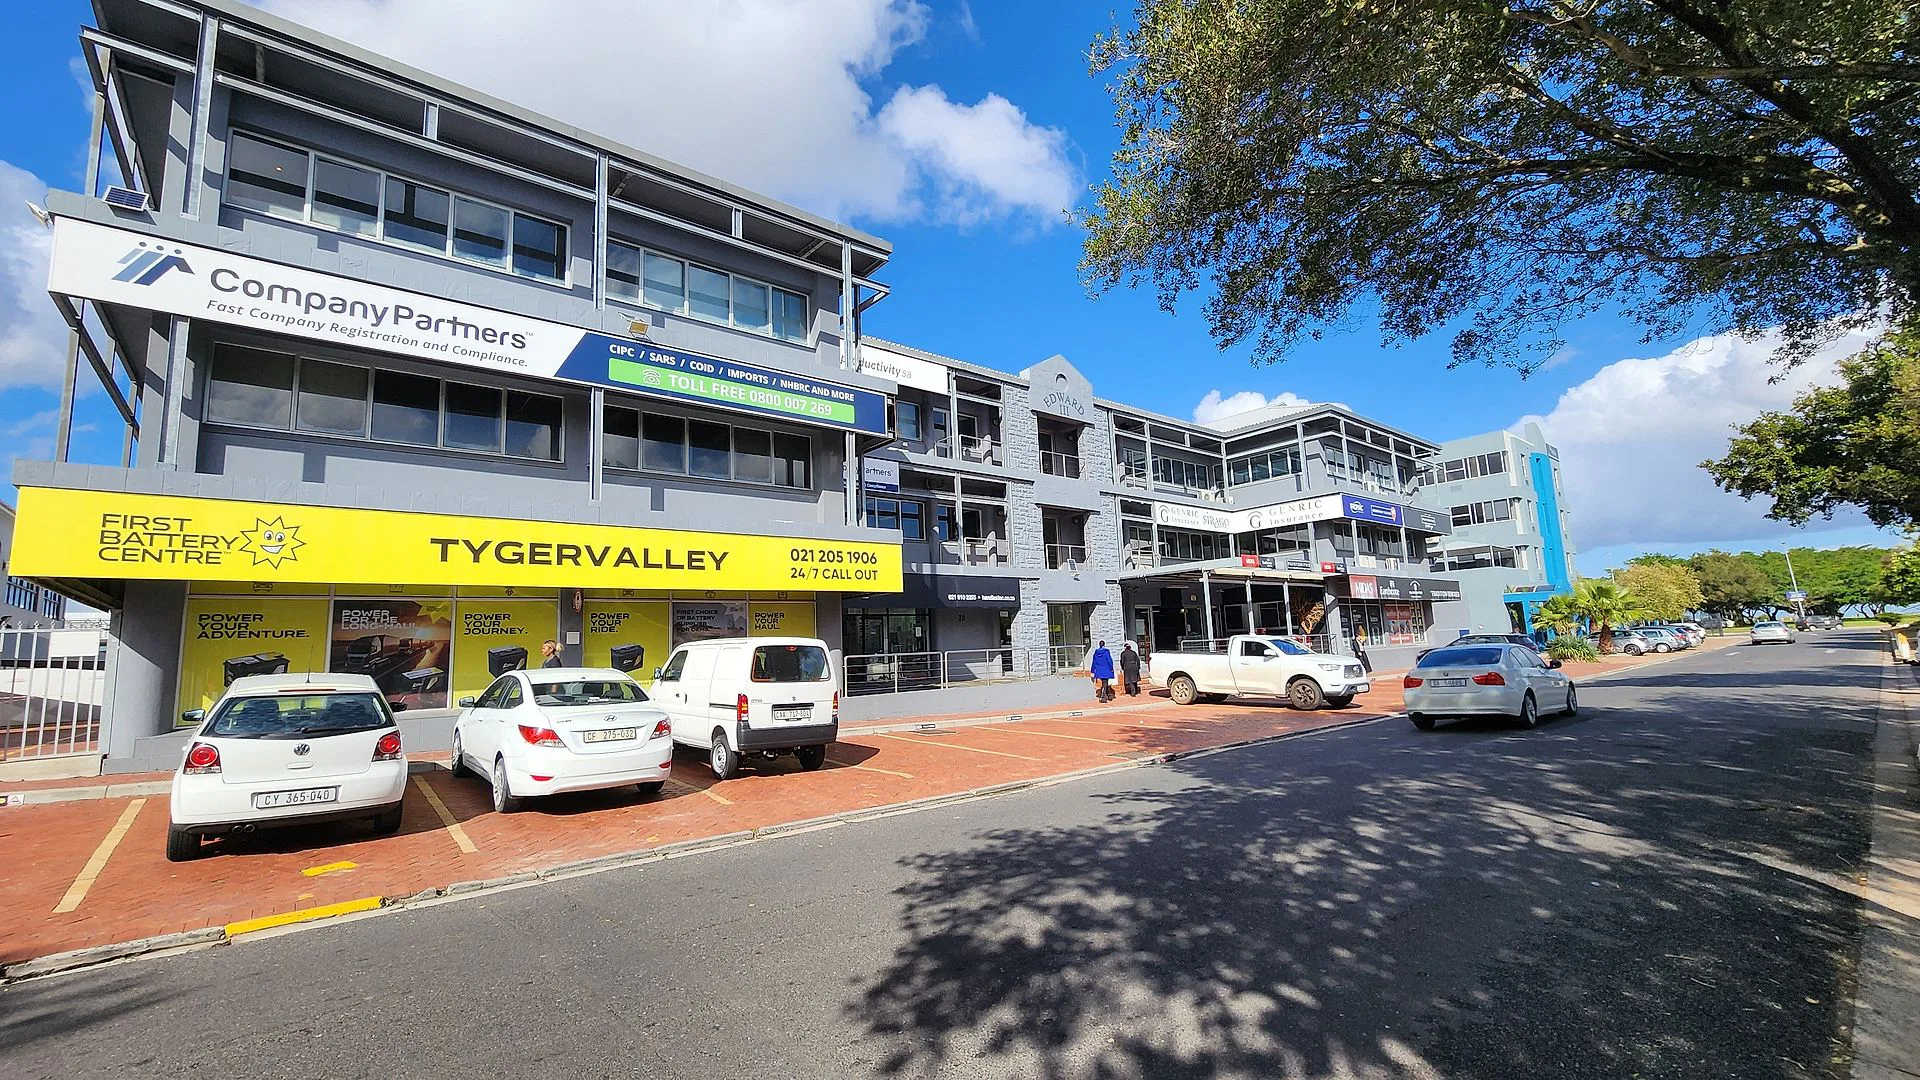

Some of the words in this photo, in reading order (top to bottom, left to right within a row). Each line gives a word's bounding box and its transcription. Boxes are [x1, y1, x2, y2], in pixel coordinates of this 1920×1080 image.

[206, 299, 244, 316] Fast
[249, 308, 326, 332] Company
[329, 322, 419, 347] Registration
[423, 341, 449, 352] and
[452, 345, 528, 367] Compliance.
[609, 344, 635, 358] CIPC
[649, 352, 676, 366] SARS
[689, 360, 715, 374] COID
[727, 368, 769, 385] IMPORTS
[780, 379, 811, 393] NHBRC
[811, 385, 830, 397] AND
[831, 390, 855, 402] MORE
[668, 373, 708, 393] TOLL
[711, 382, 746, 401] FREE
[749, 389, 781, 407] 0800
[784, 396, 807, 411] 007
[810, 401, 832, 416] 269
[1043, 391, 1085, 416] EDWARD
[1059, 404, 1070, 416] III
[1268, 499, 1323, 516] GENRIC
[102, 513, 192, 532] FIRST
[100, 530, 239, 550] BATTERY
[430, 538, 729, 571] TYGERVALLEY
[790, 548, 815, 562] 021
[818, 550, 844, 563] 205
[847, 551, 877, 565] 1906
[790, 566, 819, 580] 24/7
[822, 568, 852, 580] CALL
[854, 569, 878, 580] OUT
[198, 613, 264, 622] POWER
[341, 609, 391, 618] POWER
[464, 613, 512, 621] POWER
[590, 612, 630, 620] POWER
[341, 616, 370, 624] FOR
[374, 616, 399, 624] THE
[463, 620, 501, 628] YOUR
[590, 619, 622, 627] YOUR
[197, 622, 250, 631] YOUR
[463, 627, 529, 636] JOURNEY.
[590, 626, 619, 634] RIDE.
[196, 630, 310, 640] ADVENTURE.
[587, 732, 596, 741] CF
[264, 794, 280, 806] CY
[286, 789, 330, 804] 365-040
